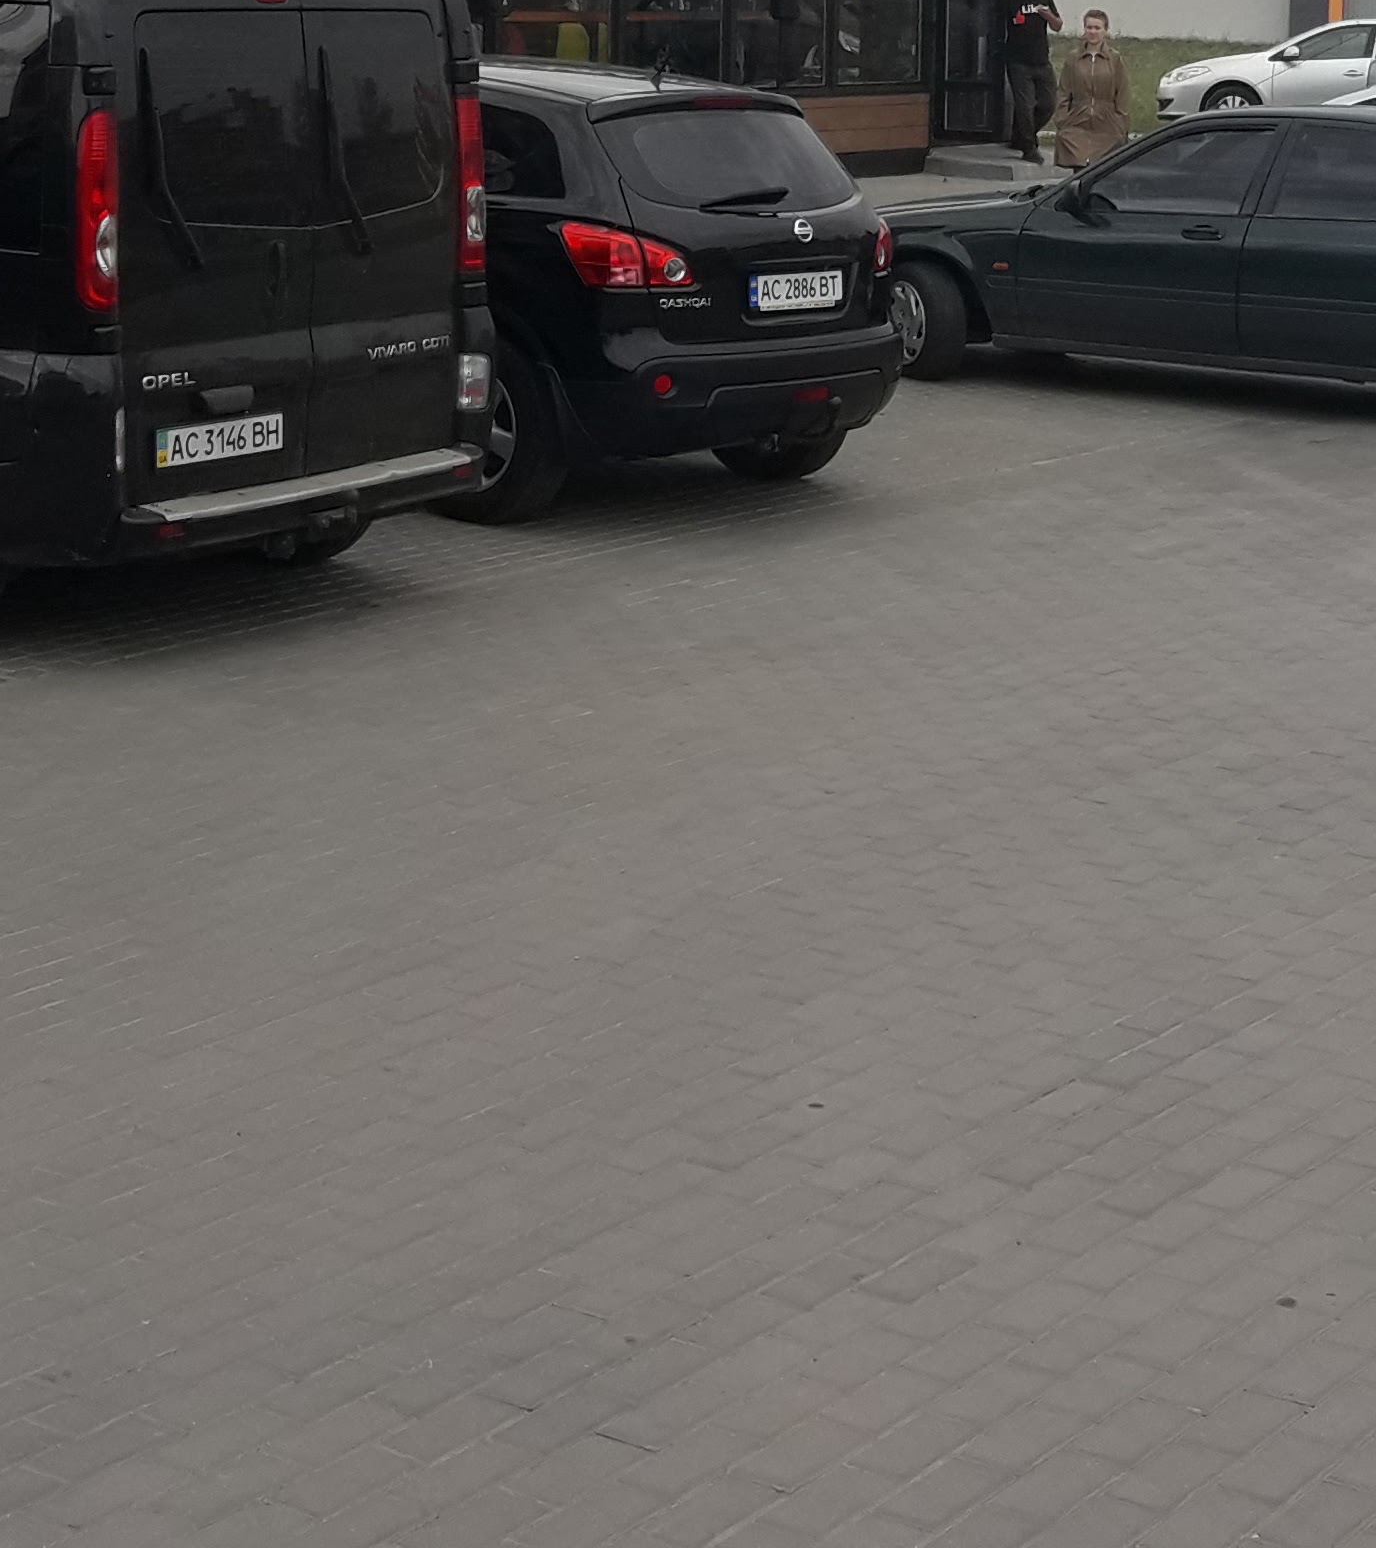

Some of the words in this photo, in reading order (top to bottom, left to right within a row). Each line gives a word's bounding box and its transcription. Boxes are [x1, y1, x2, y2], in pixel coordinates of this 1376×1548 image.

[761, 279, 782, 302] AC
[785, 276, 816, 300] 2886
[819, 275, 838, 297] BT
[659, 297, 711, 309] QASHQAI
[142, 372, 197, 390] OPEL
[171, 433, 199, 462] AC
[204, 424, 247, 456] 3146
[252, 418, 279, 448] BH
